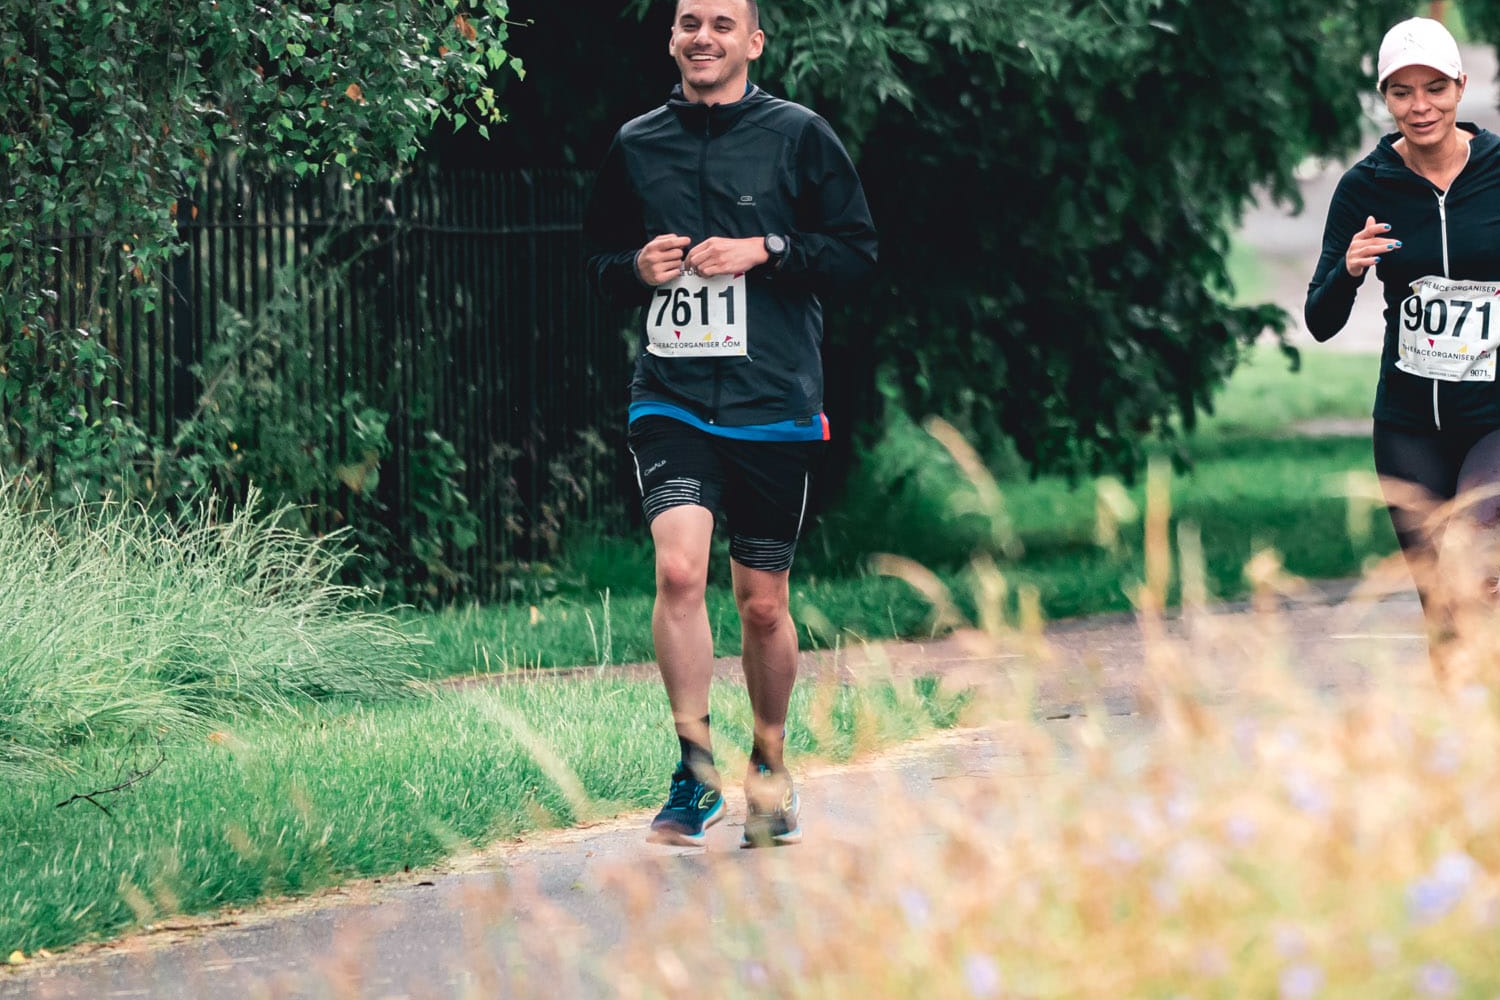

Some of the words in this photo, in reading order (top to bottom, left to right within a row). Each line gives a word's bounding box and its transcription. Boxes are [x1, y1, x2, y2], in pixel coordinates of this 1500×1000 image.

[1451, 284, 1497, 293] ORGANISER
[655, 286, 735, 327] 7611
[1404, 295, 1491, 340] 9071
[1470, 369, 1487, 377] 9071
